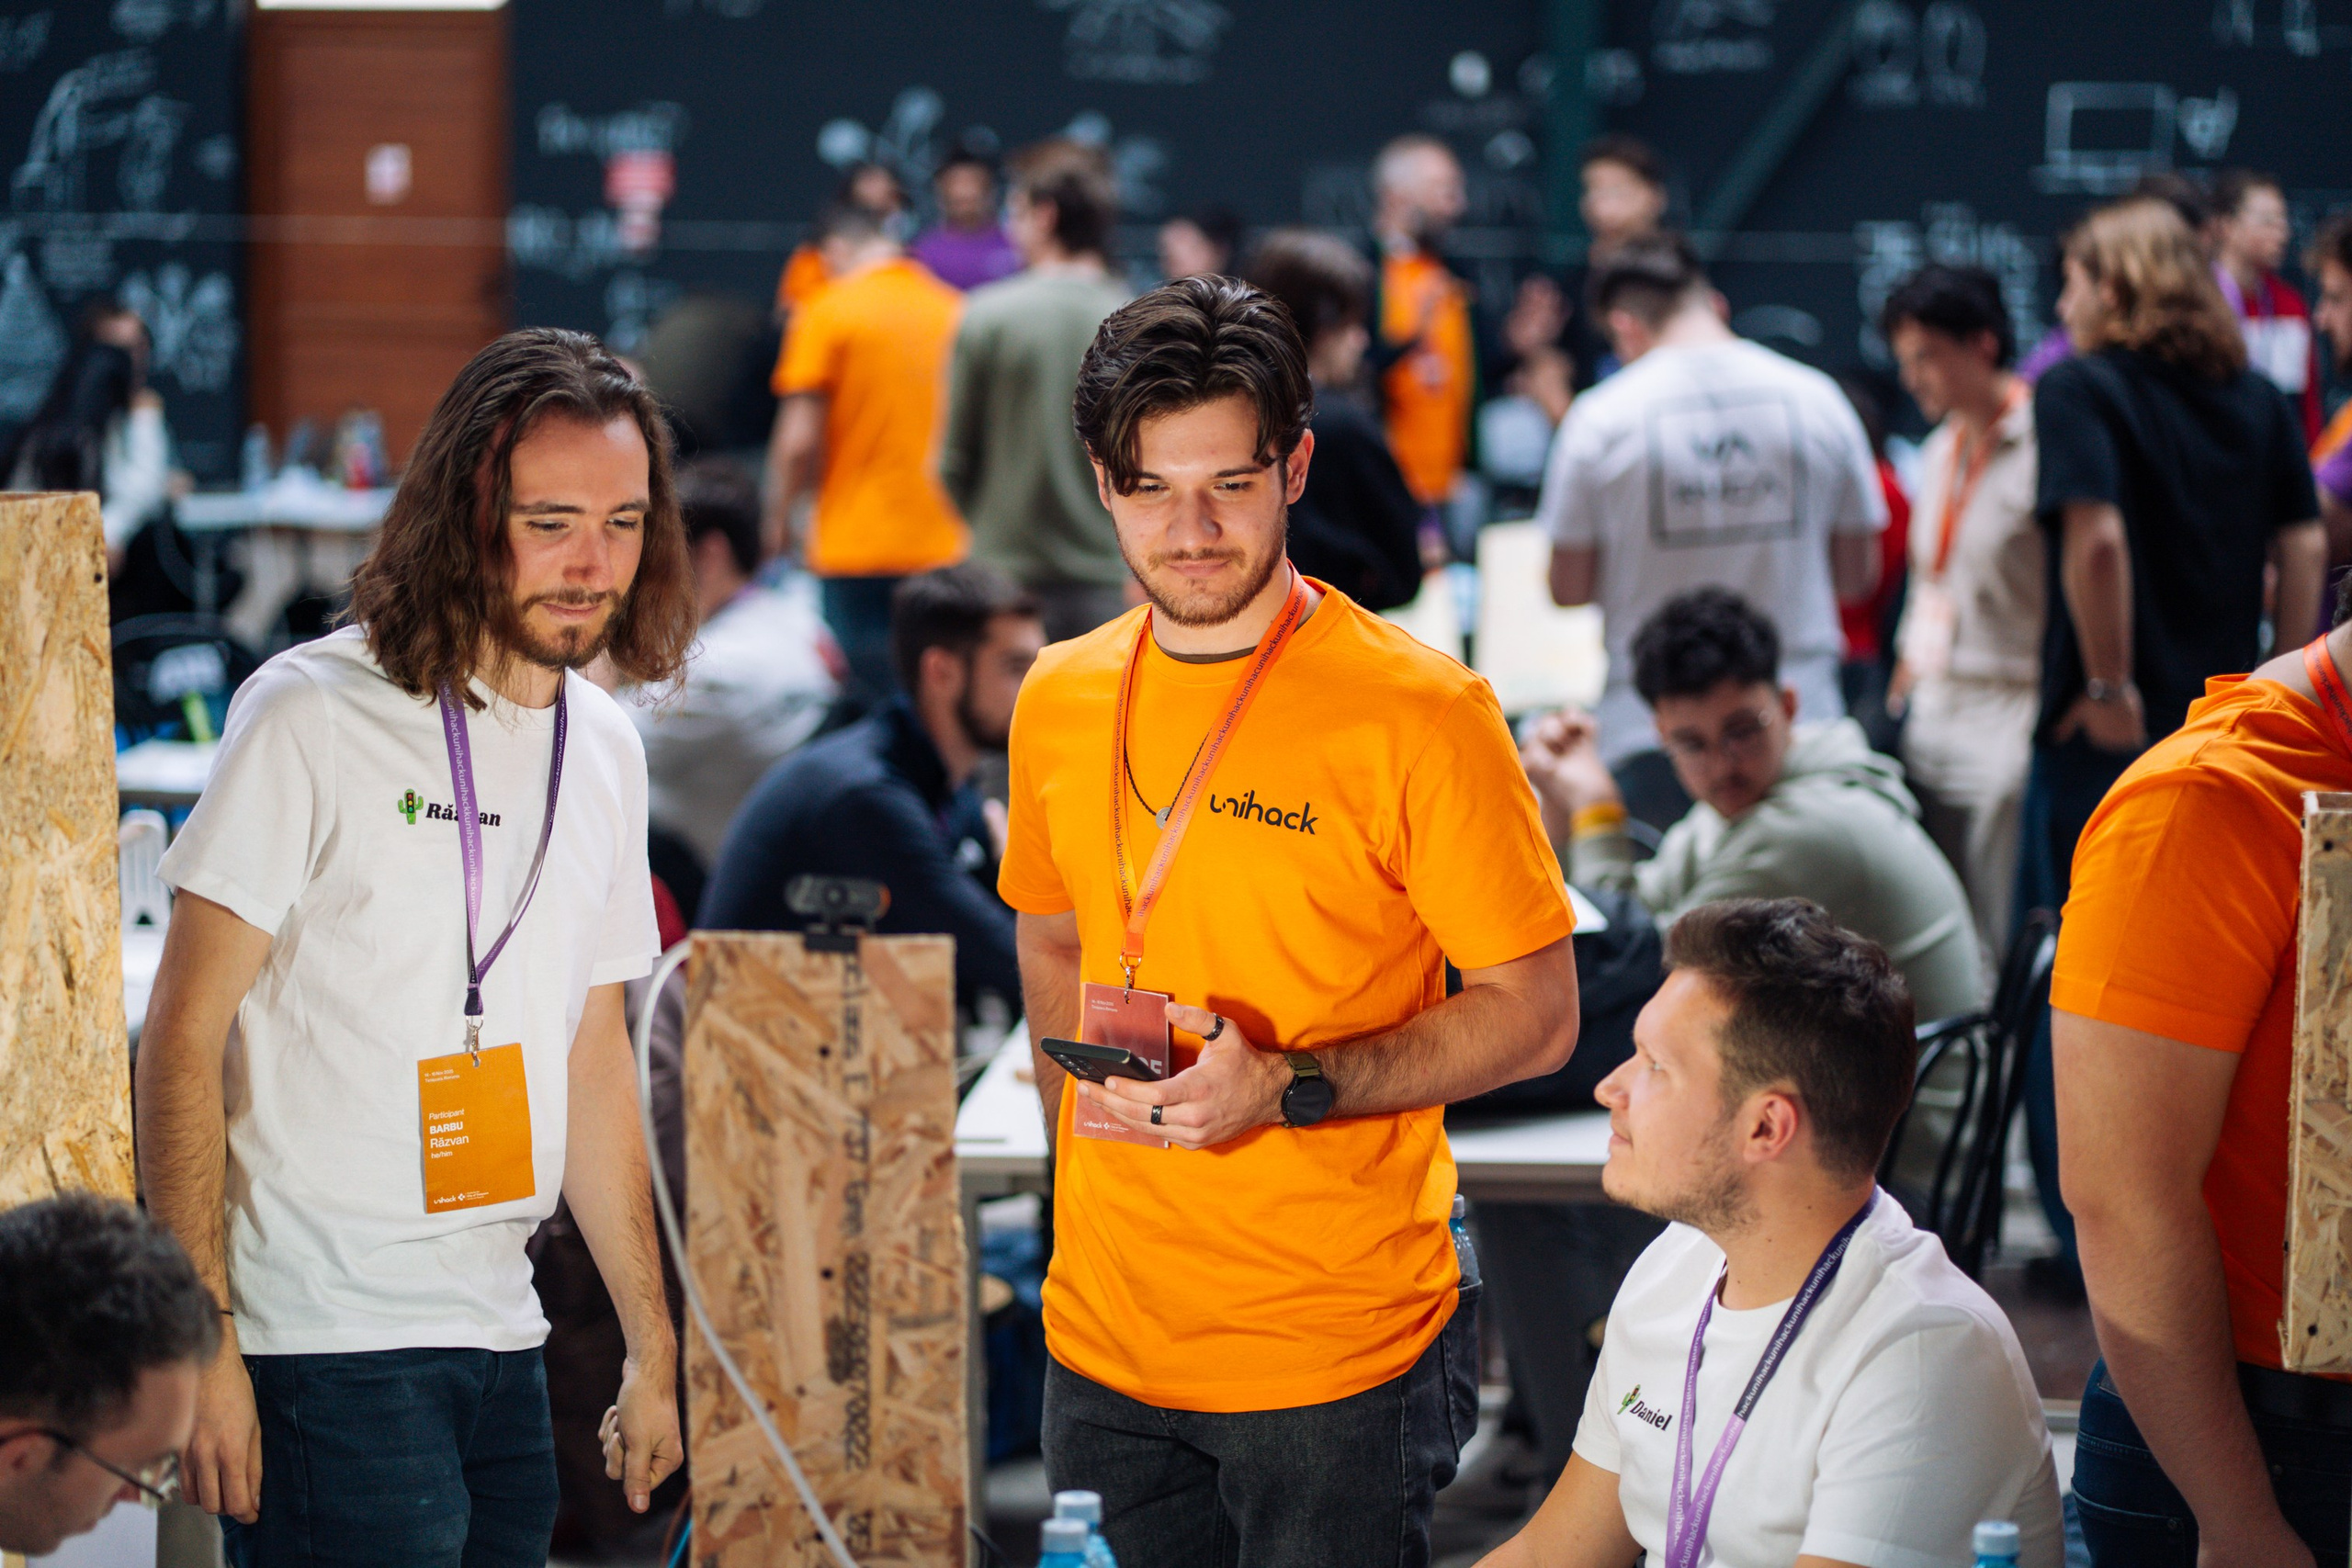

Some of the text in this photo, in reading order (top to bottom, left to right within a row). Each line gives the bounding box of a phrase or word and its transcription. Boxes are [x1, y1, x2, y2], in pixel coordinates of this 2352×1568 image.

[425, 803, 502, 827] Răan
[1210, 790, 1318, 835] unihack
[428, 1108, 465, 1121] Participant
[429, 1121, 464, 1134] BARBU
[430, 1135, 469, 1148] Răzvan
[431, 1150, 453, 1159] he/him
[1629, 1400, 1673, 1431] Daniel
